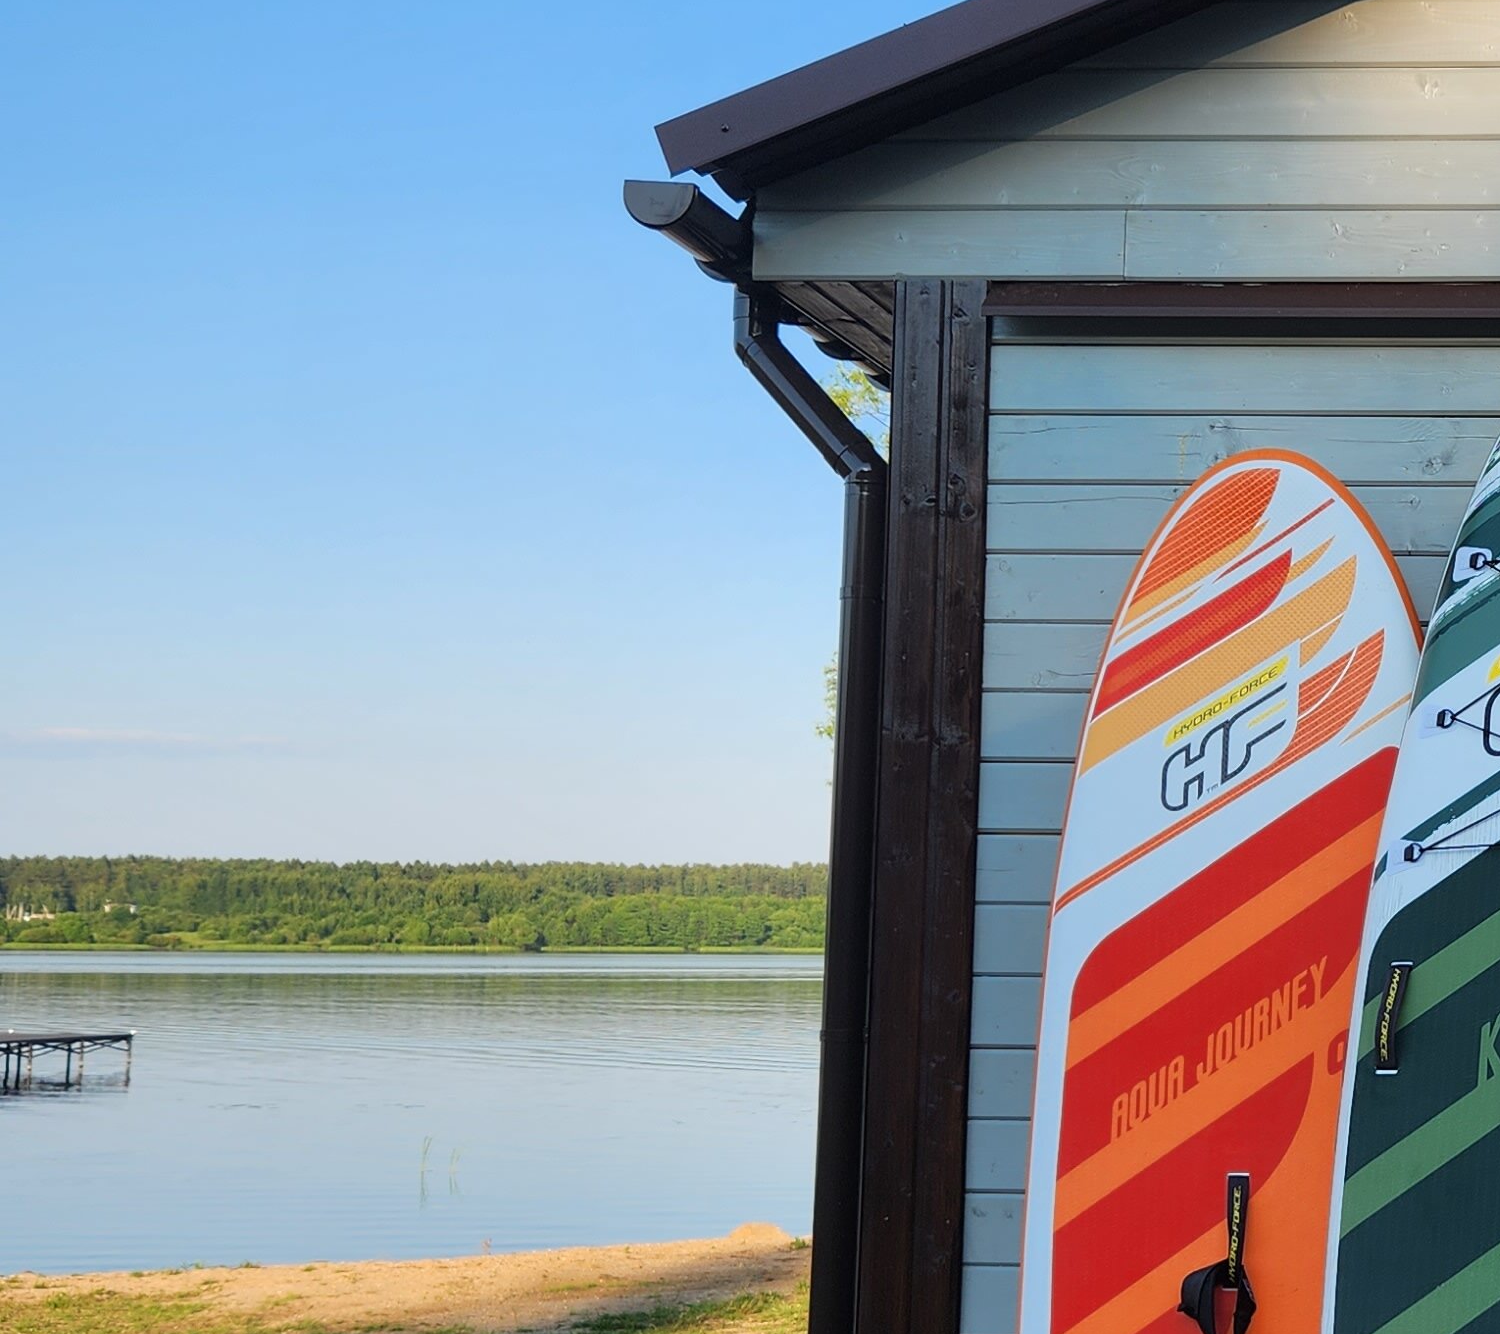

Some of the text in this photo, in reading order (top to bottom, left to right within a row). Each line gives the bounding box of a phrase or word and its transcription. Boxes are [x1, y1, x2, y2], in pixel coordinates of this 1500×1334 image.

[1173, 665, 1280, 739] HYDRO-FORCE
[1110, 1055, 1185, 1142] AQUA
[1196, 955, 1327, 1083] JOURNEY
